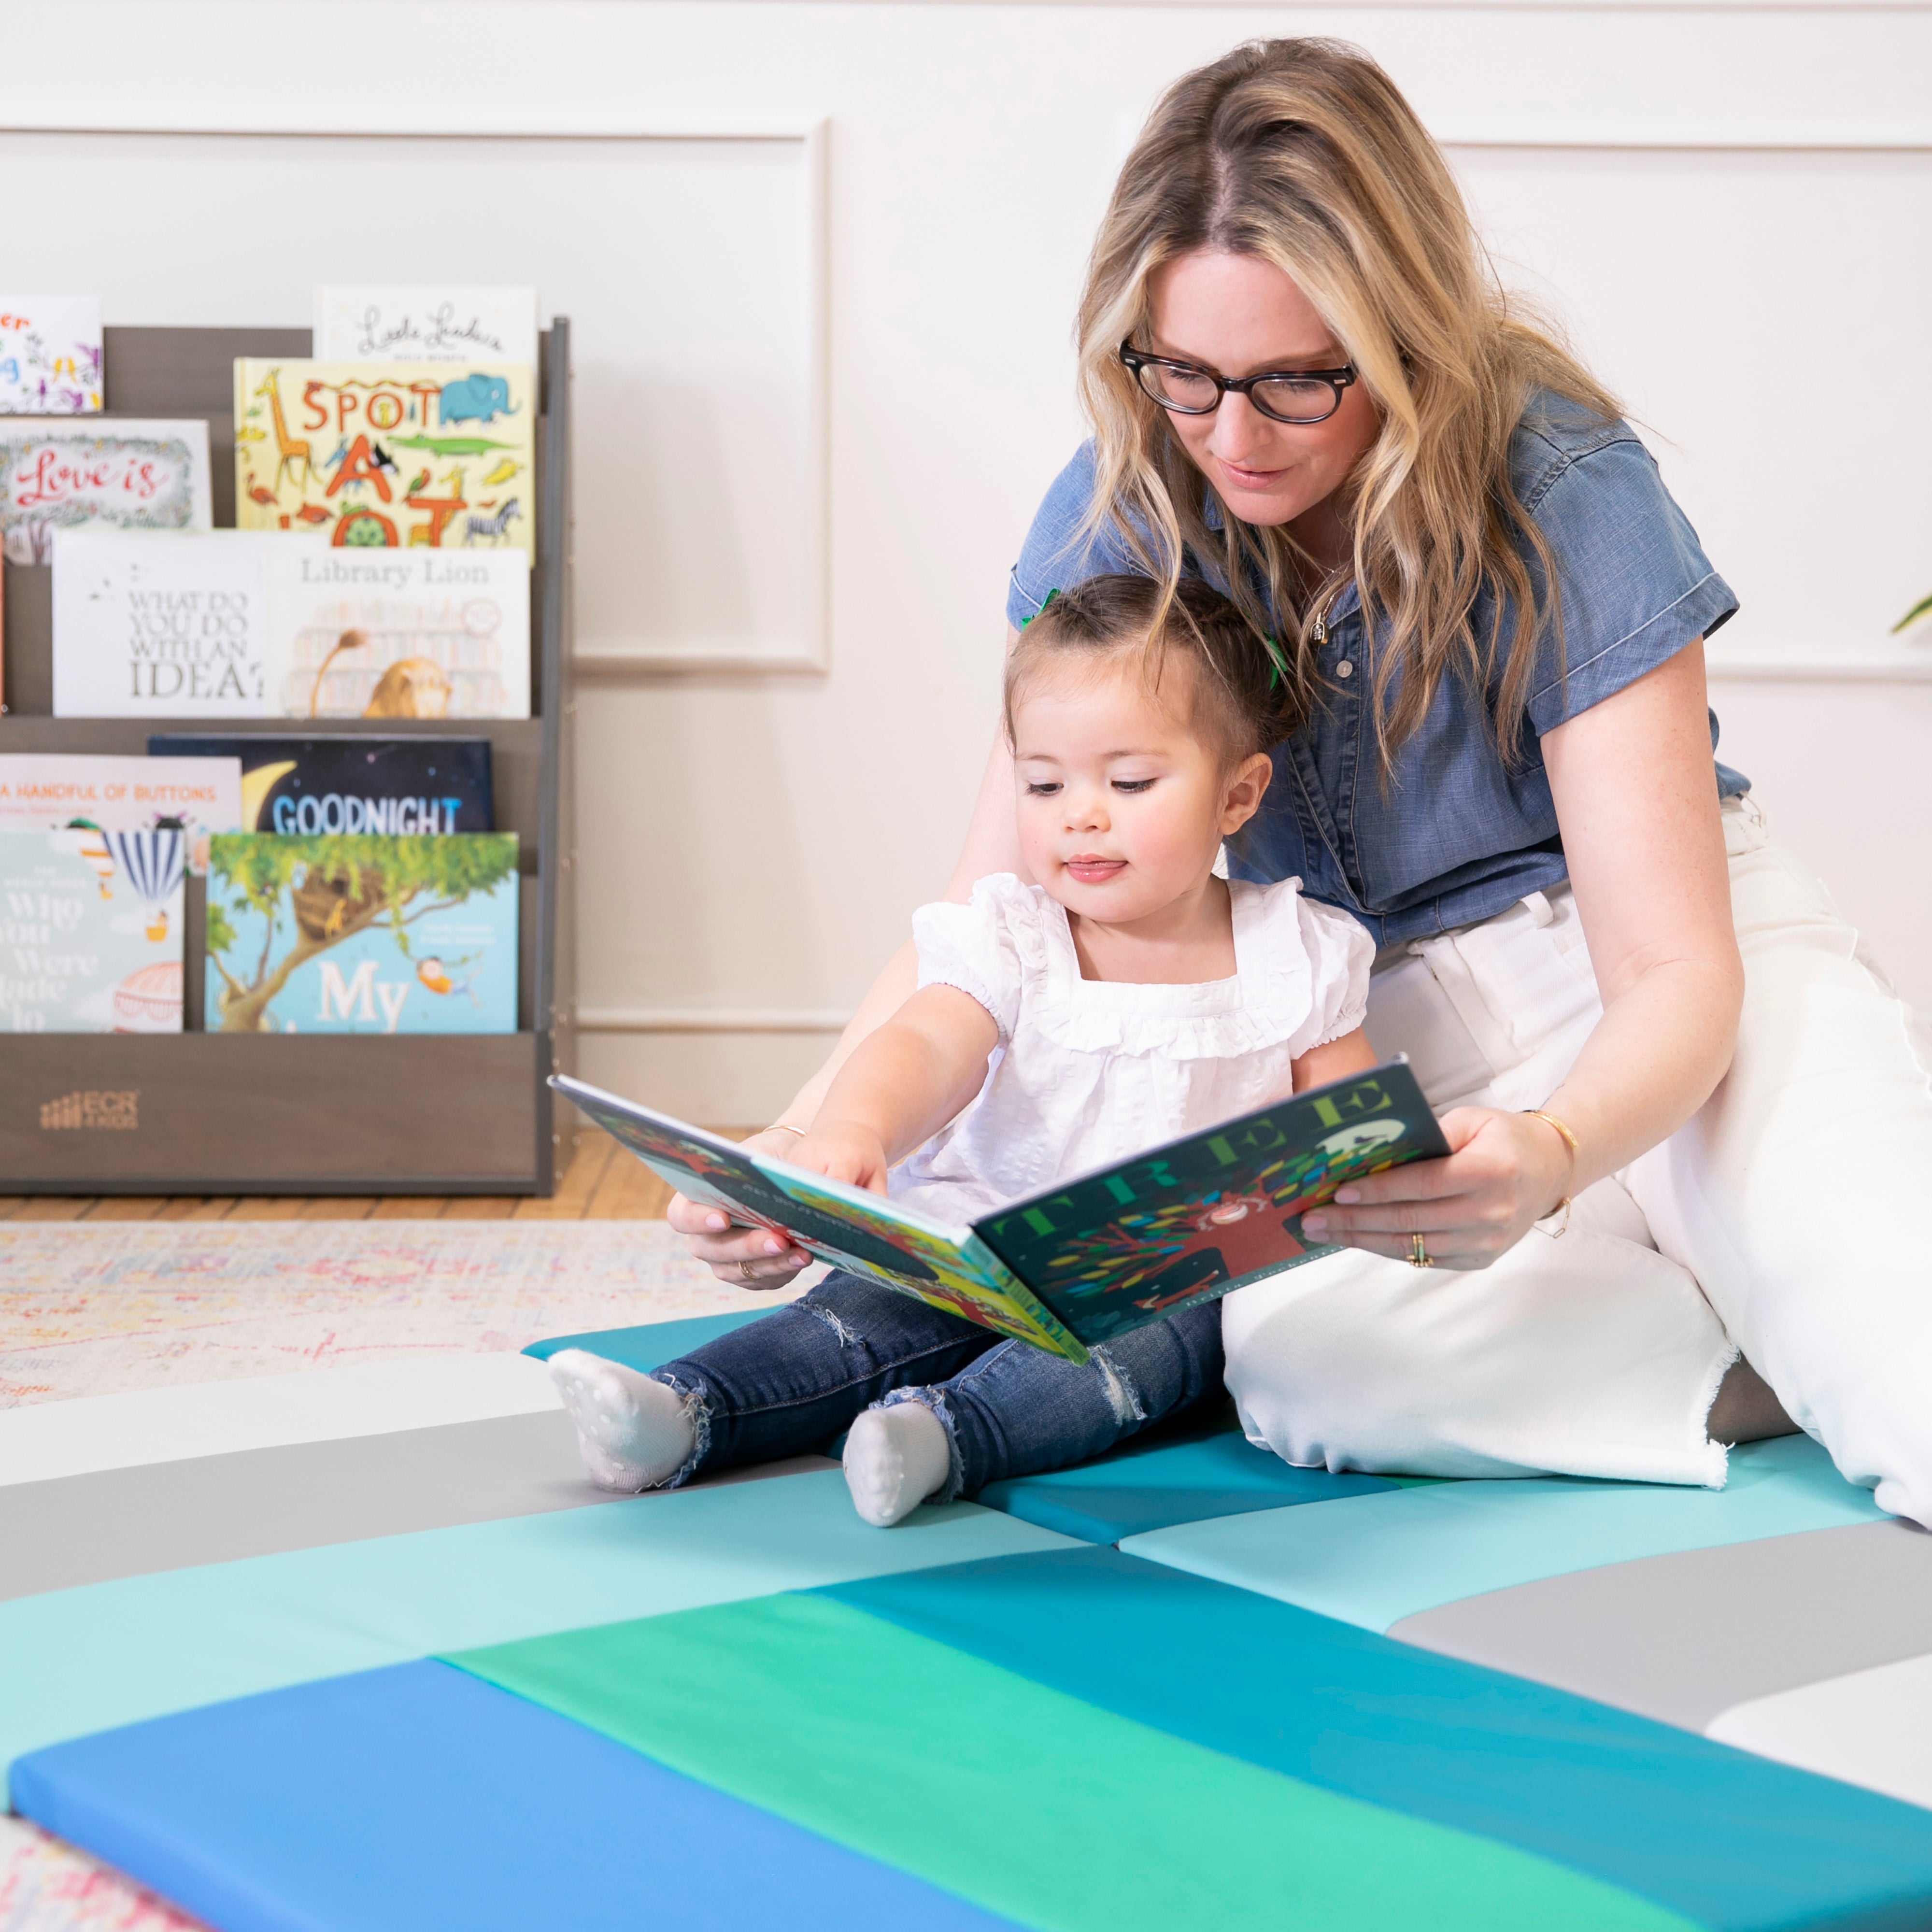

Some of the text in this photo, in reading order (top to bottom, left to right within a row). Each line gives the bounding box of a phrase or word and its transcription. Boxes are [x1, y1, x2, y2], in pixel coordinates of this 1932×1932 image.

[303, 381, 442, 432] SPOT
[16, 449, 169, 506] Love is
[326, 434, 392, 504] A
[300, 557, 490, 589] Library Lion
[128, 590, 248, 612] WHAT DO
[130, 613, 248, 639] YOU DO
[129, 639, 247, 659] WITH AN
[16, 782, 99, 802] HANDFUL
[103, 783, 127, 802] OF
[134, 784, 217, 803] BUTTONS
[272, 792, 462, 835] GOODNIGHT
[314, 960, 412, 1033] My
[991, 1079, 1393, 1238] TREE
